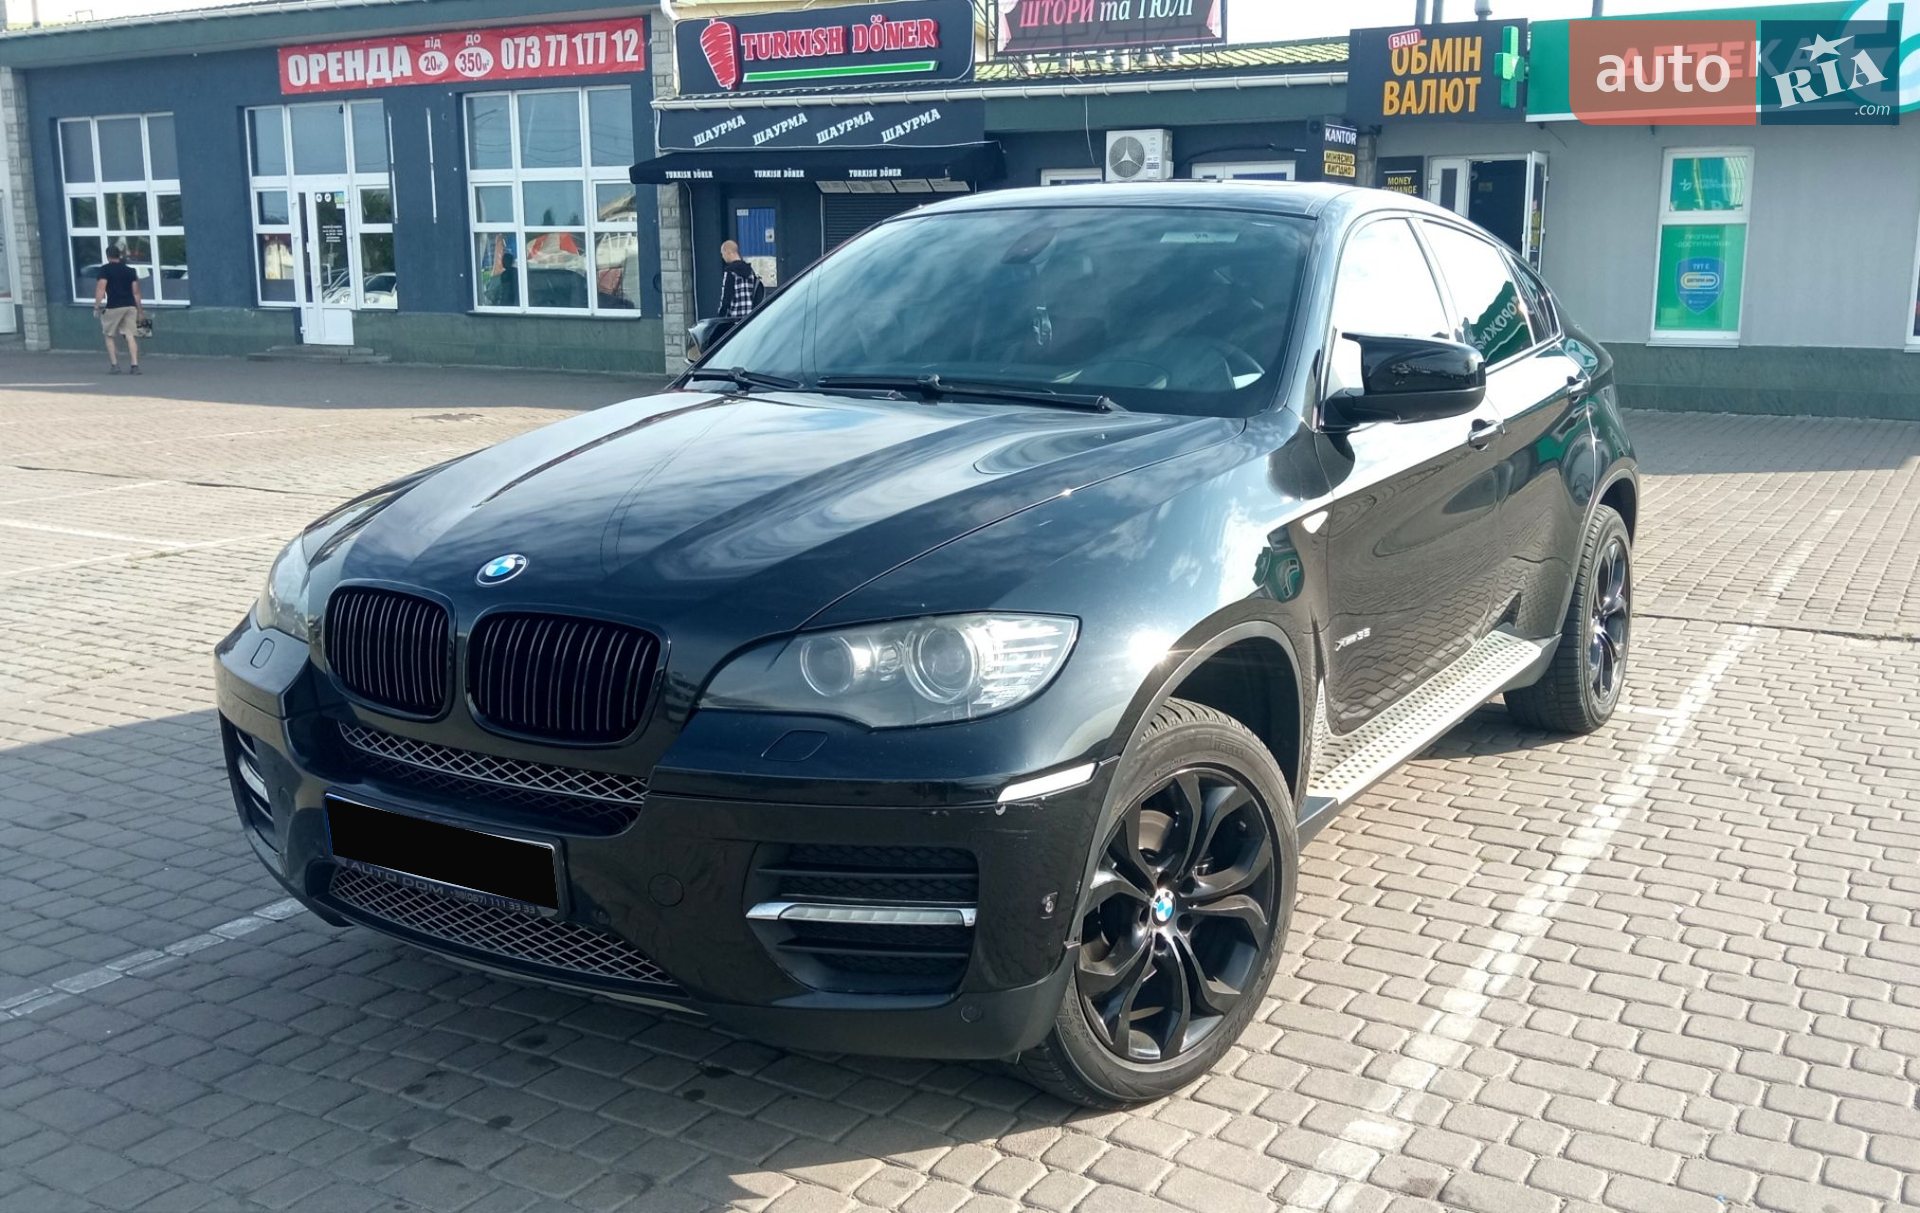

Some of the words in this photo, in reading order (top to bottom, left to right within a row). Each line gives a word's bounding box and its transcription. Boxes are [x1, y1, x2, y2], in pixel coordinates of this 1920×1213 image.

[1019, 0, 1095, 28] ШТОРИ
[465, 33, 482, 47] до
[501, 35, 541, 70] 073
[545, 34, 568, 67] 77
[572, 31, 607, 65] 177
[611, 29, 639, 63] 12
[741, 25, 846, 61] TURKISH
[852, 14, 940, 53] DÖNER
[1392, 32, 1418, 48] ВАШ
[287, 45, 413, 87] ОРЕНДА
[1391, 36, 1482, 75] ОБМІН
[1383, 76, 1482, 115] ВАЛЮТ
[693, 114, 746, 147] ШАУРМА
[752, 112, 808, 146] ШАУРМА
[816, 110, 875, 144] ШАУРМА
[881, 108, 942, 143] ШАУРМА
[1325, 128, 1357, 145] KANTOR
[754, 169, 782, 179] TURKISH
[849, 168, 878, 178] TURKISH
[1387, 176, 1412, 185] MONEY
[351, 861, 397, 883] AUTO
[402, 876, 444, 895] DOM
